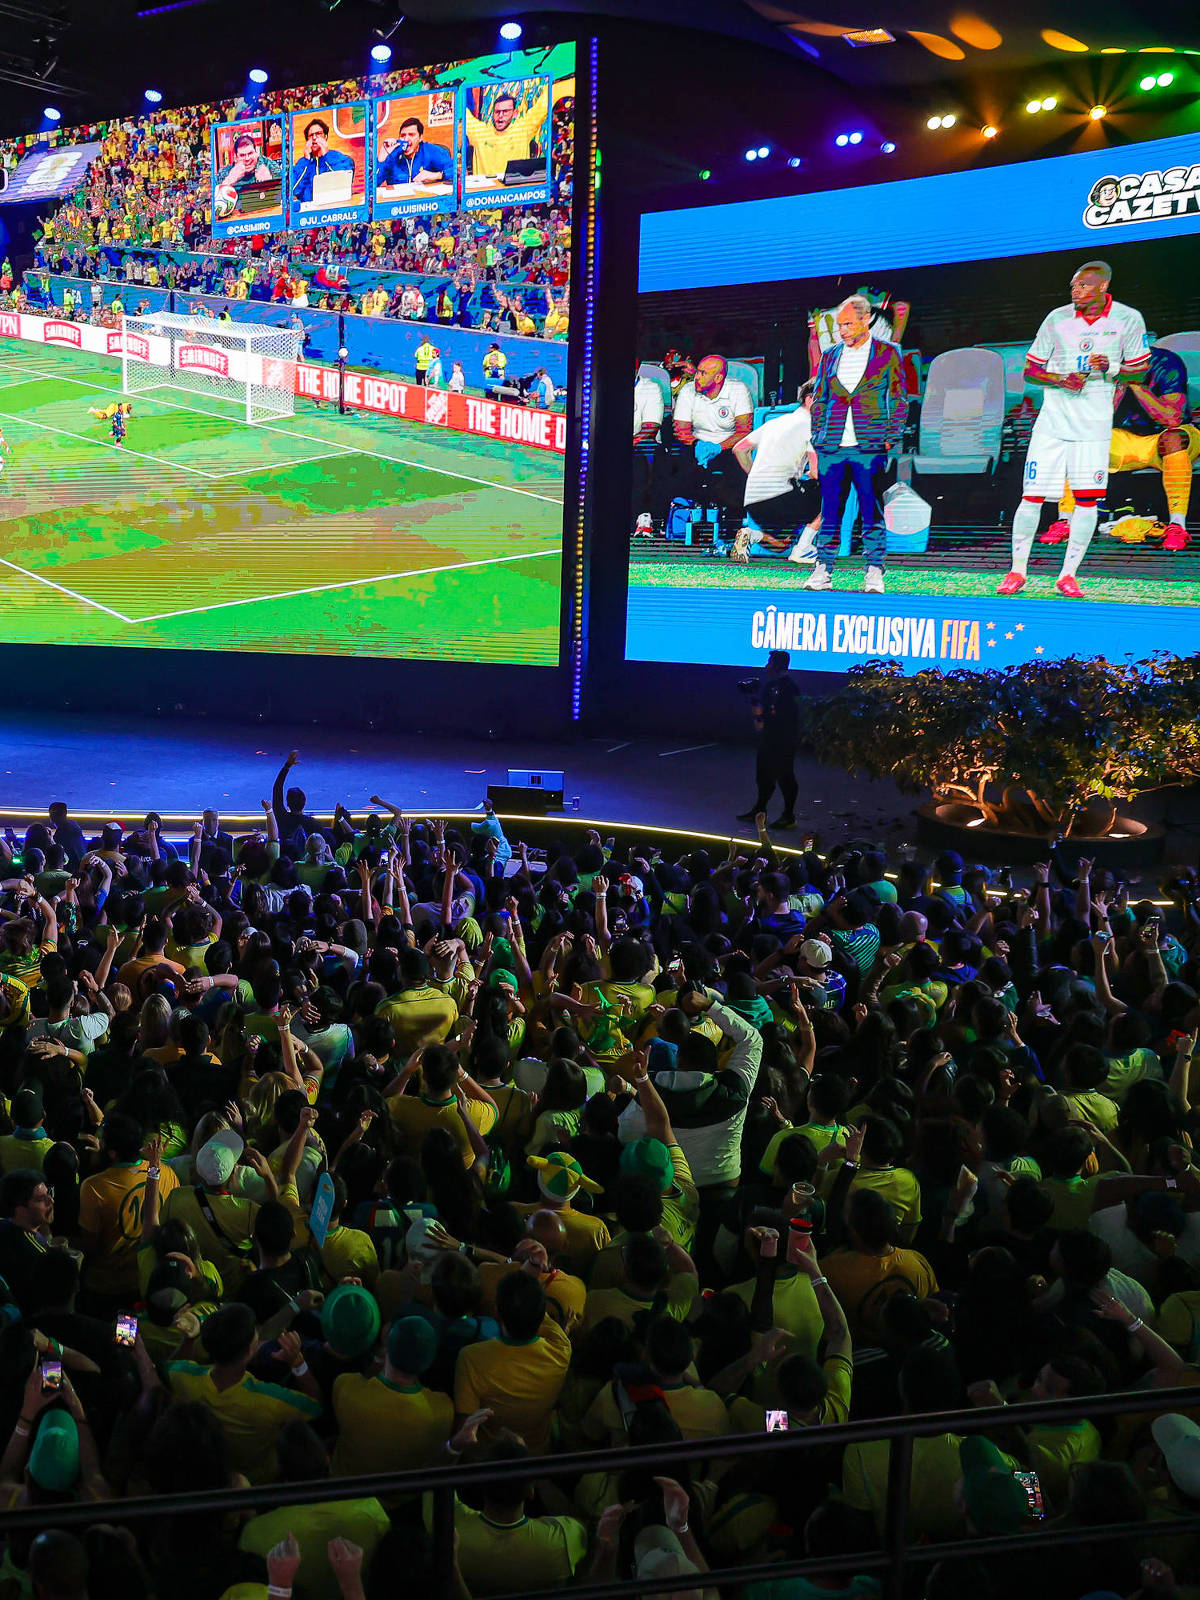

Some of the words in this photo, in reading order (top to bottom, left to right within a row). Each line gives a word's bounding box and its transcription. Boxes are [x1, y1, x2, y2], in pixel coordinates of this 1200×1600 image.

[466, 190, 546, 208] @DONANCAMPOS
[1120, 166, 1200, 200] CASA
[391, 202, 439, 216] @LUISINHO
[1086, 190, 1200, 226] CAZET
[227, 222, 271, 235] @CASIMIRO
[298, 366, 321, 396] THE
[364, 376, 408, 414] DEPOT
[466, 398, 496, 434] THE
[500, 405, 551, 446] HOME
[751, 604, 828, 652] CÂMERA
[832, 614, 936, 659] EXCLUSIVA
[940, 619, 981, 661] FIFA
